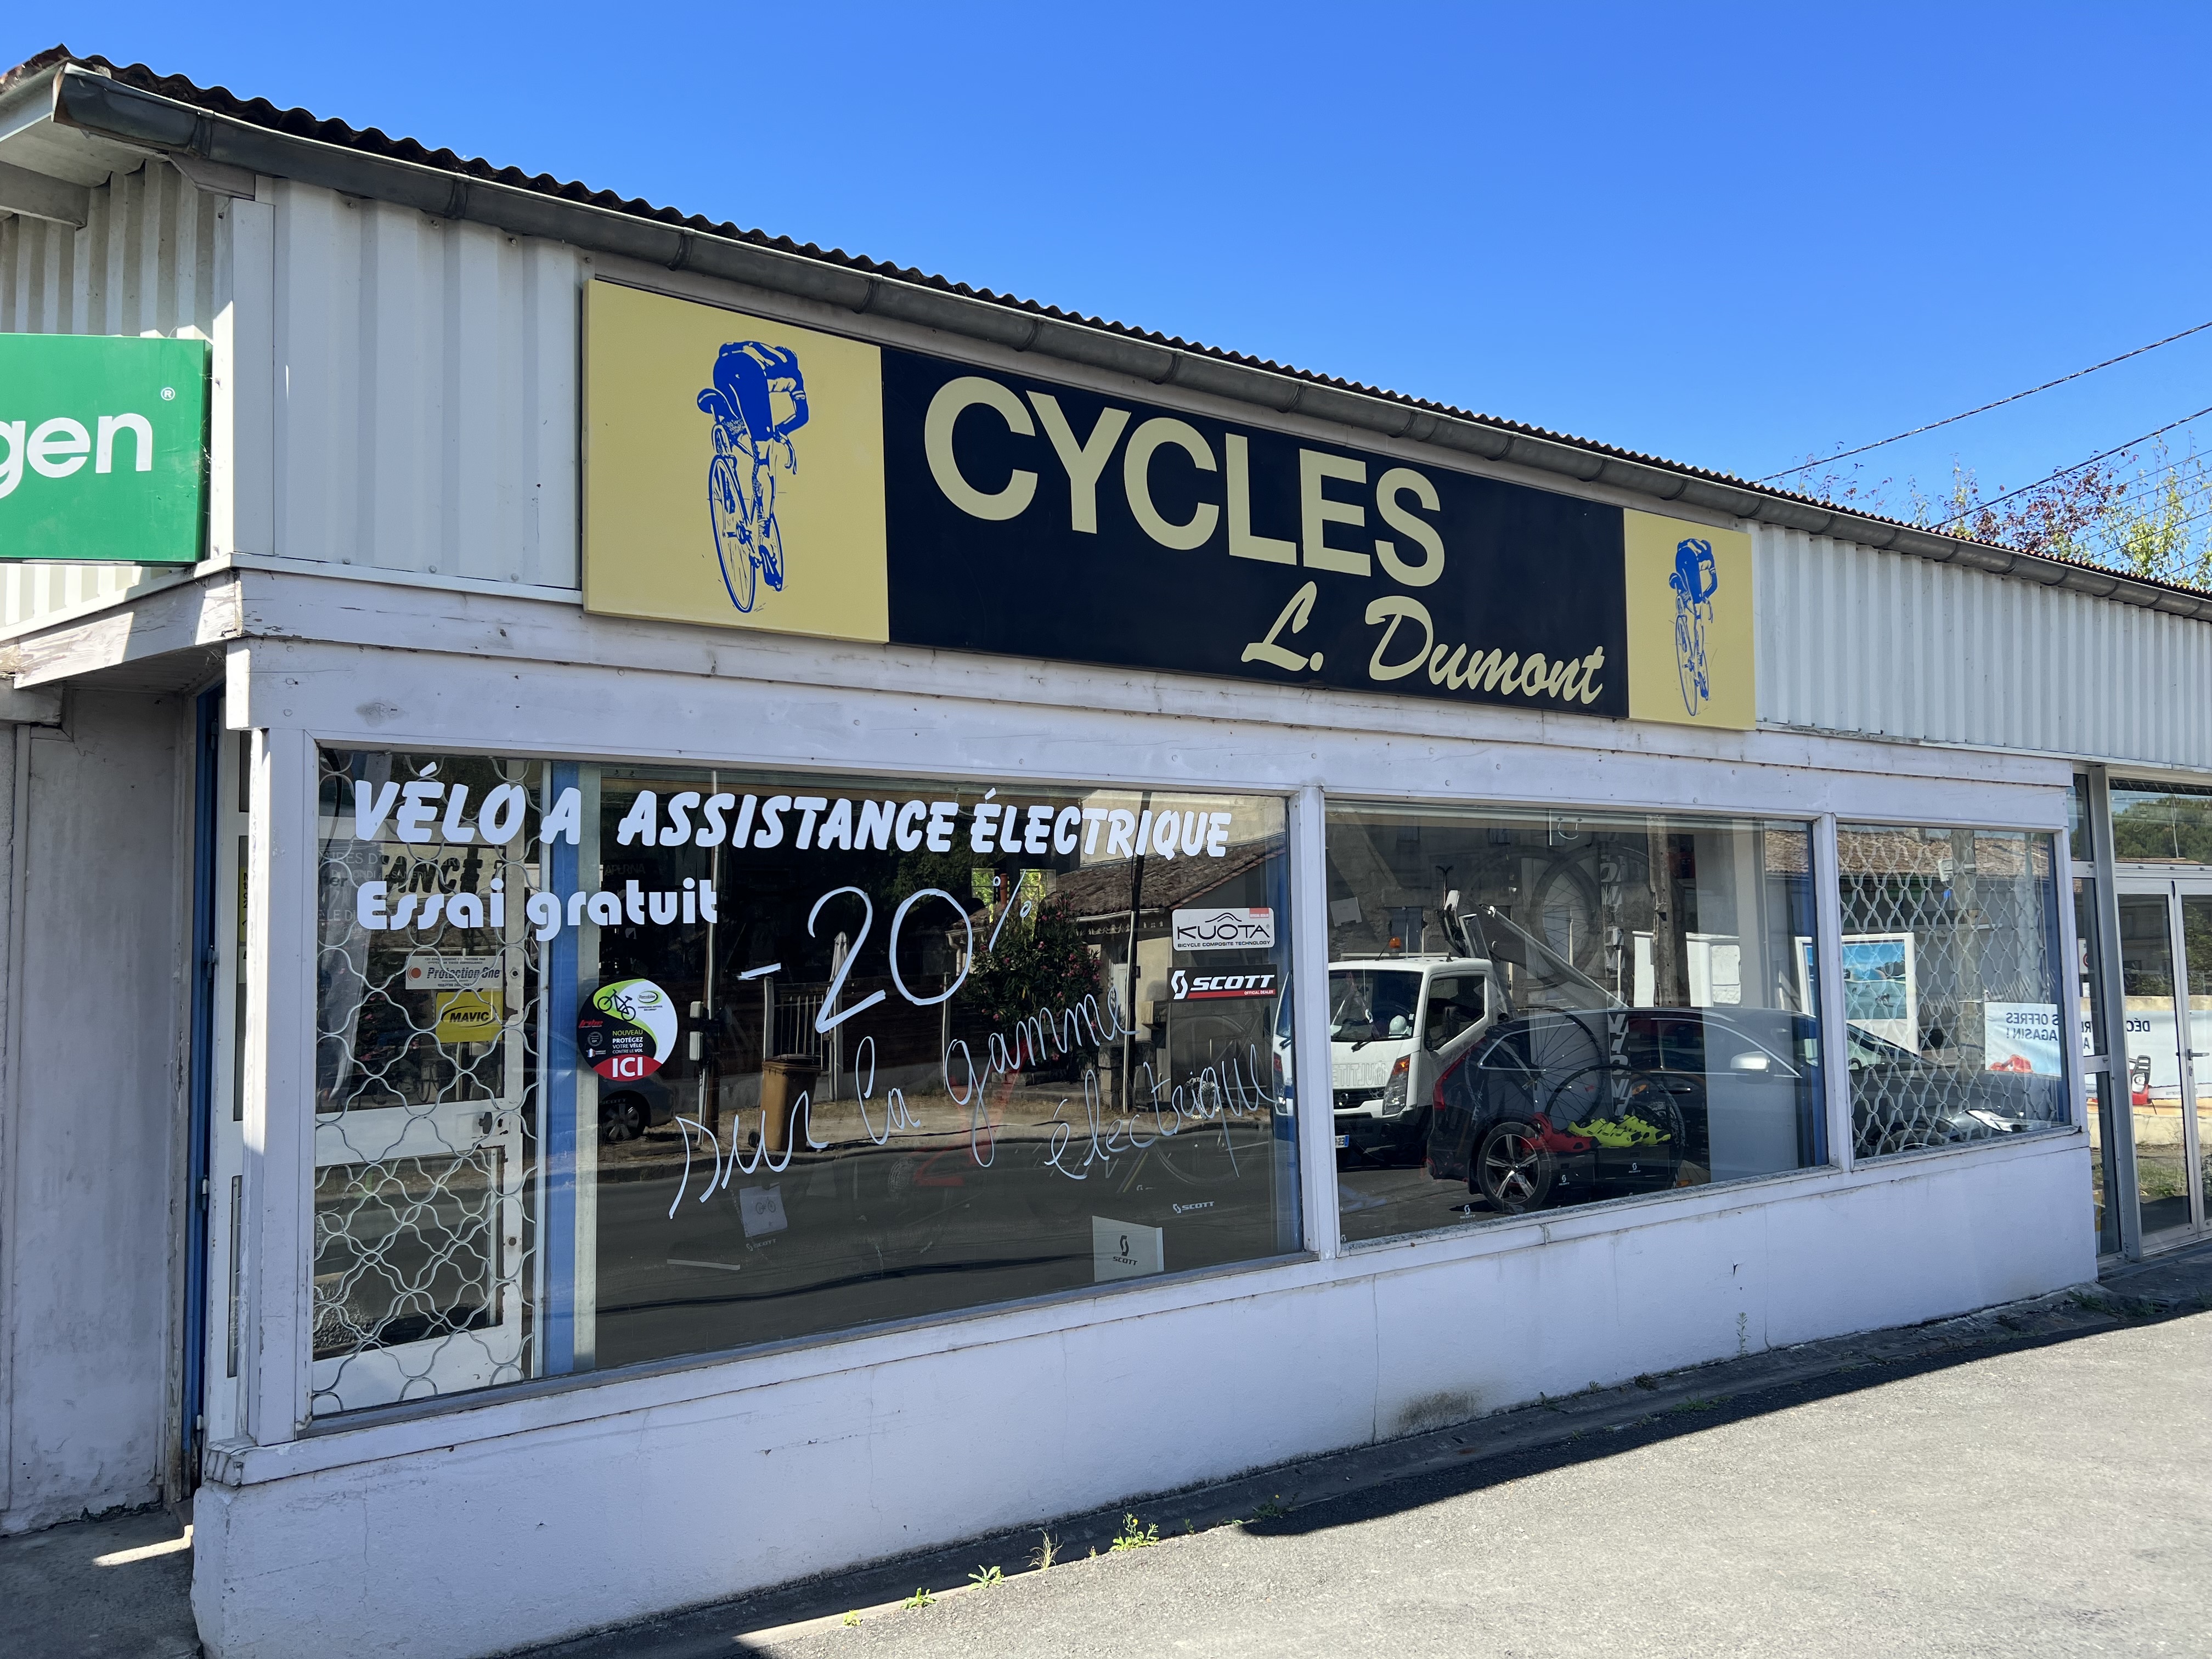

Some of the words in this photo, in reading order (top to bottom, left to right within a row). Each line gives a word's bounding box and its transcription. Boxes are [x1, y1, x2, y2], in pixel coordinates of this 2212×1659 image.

[924, 376, 1445, 587] CYCLES
[1241, 580, 1324, 672] L.
[1365, 596, 1605, 705] Dumont
[355, 761, 526, 845] VÉLO
[539, 787, 582, 845] A
[617, 789, 959, 853] ASSISTANCE
[970, 787, 1232, 861] ÉLECTRIQUE
[357, 878, 504, 930] Essai
[526, 877, 718, 942] gratuit
[1177, 924, 1270, 940] KUOTA
[427, 967, 480, 979] Protection
[1190, 974, 1276, 991] SCOTT
[449, 1012, 489, 1023] MAVIC
[612, 1056, 643, 1077] ICI
[855, 1036, 921, 1146] la
[945, 986, 1140, 1167] gamme
[1181, 1201, 1215, 1211] SCOTT
[1113, 1256, 1138, 1266] SCOTT
